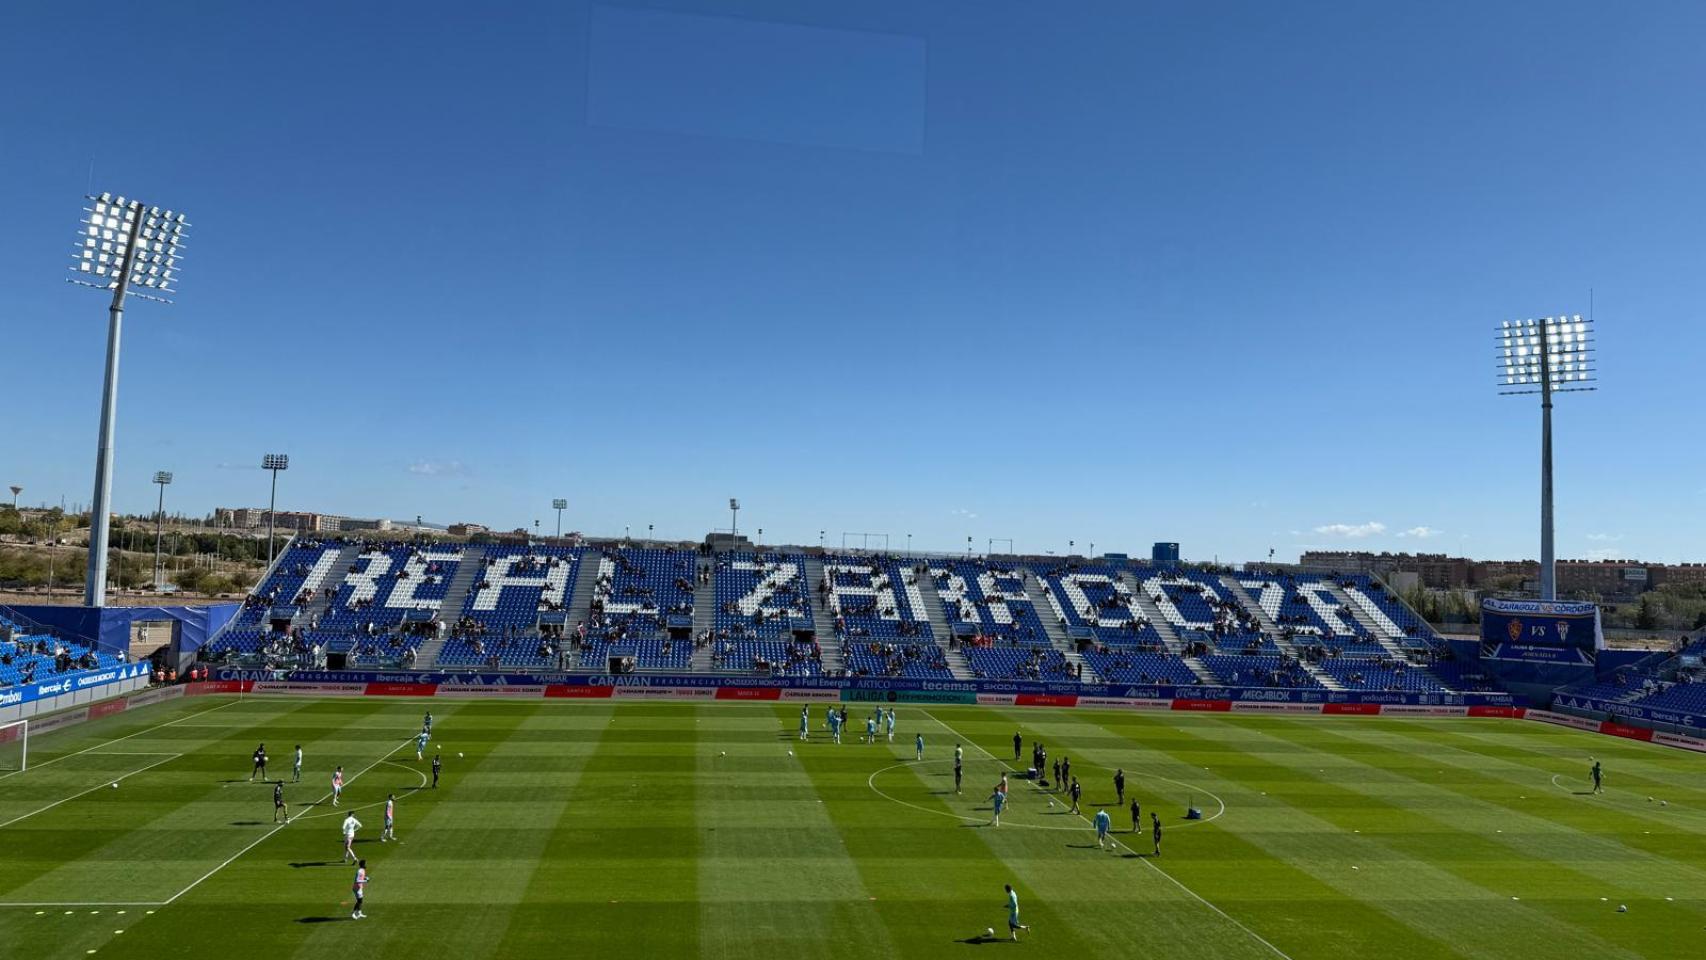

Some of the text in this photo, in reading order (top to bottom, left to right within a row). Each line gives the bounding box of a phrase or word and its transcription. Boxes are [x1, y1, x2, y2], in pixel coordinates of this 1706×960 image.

[291, 549, 1404, 638] REAL ZARAGOZA
[1498, 602, 1540, 610] ZARAGOZA
[1531, 625, 1545, 637] VS
[376, 674, 413, 683] Ibercaja
[588, 676, 651, 686] CARAVAN
[802, 678, 851, 688] Full Energía
[38, 684, 61, 696] Ibercaja
[922, 680, 977, 691] tecemac
[1048, 683, 1078, 692] telpark
[1080, 684, 1109, 693] telpark
[850, 690, 884, 701] LALIGA
[1240, 690, 1289, 700] MEGABLOK
[1361, 693, 1399, 703] podoactiva
[1490, 695, 1513, 703] AMBAR
[1650, 711, 1679, 722] Ibercaja
